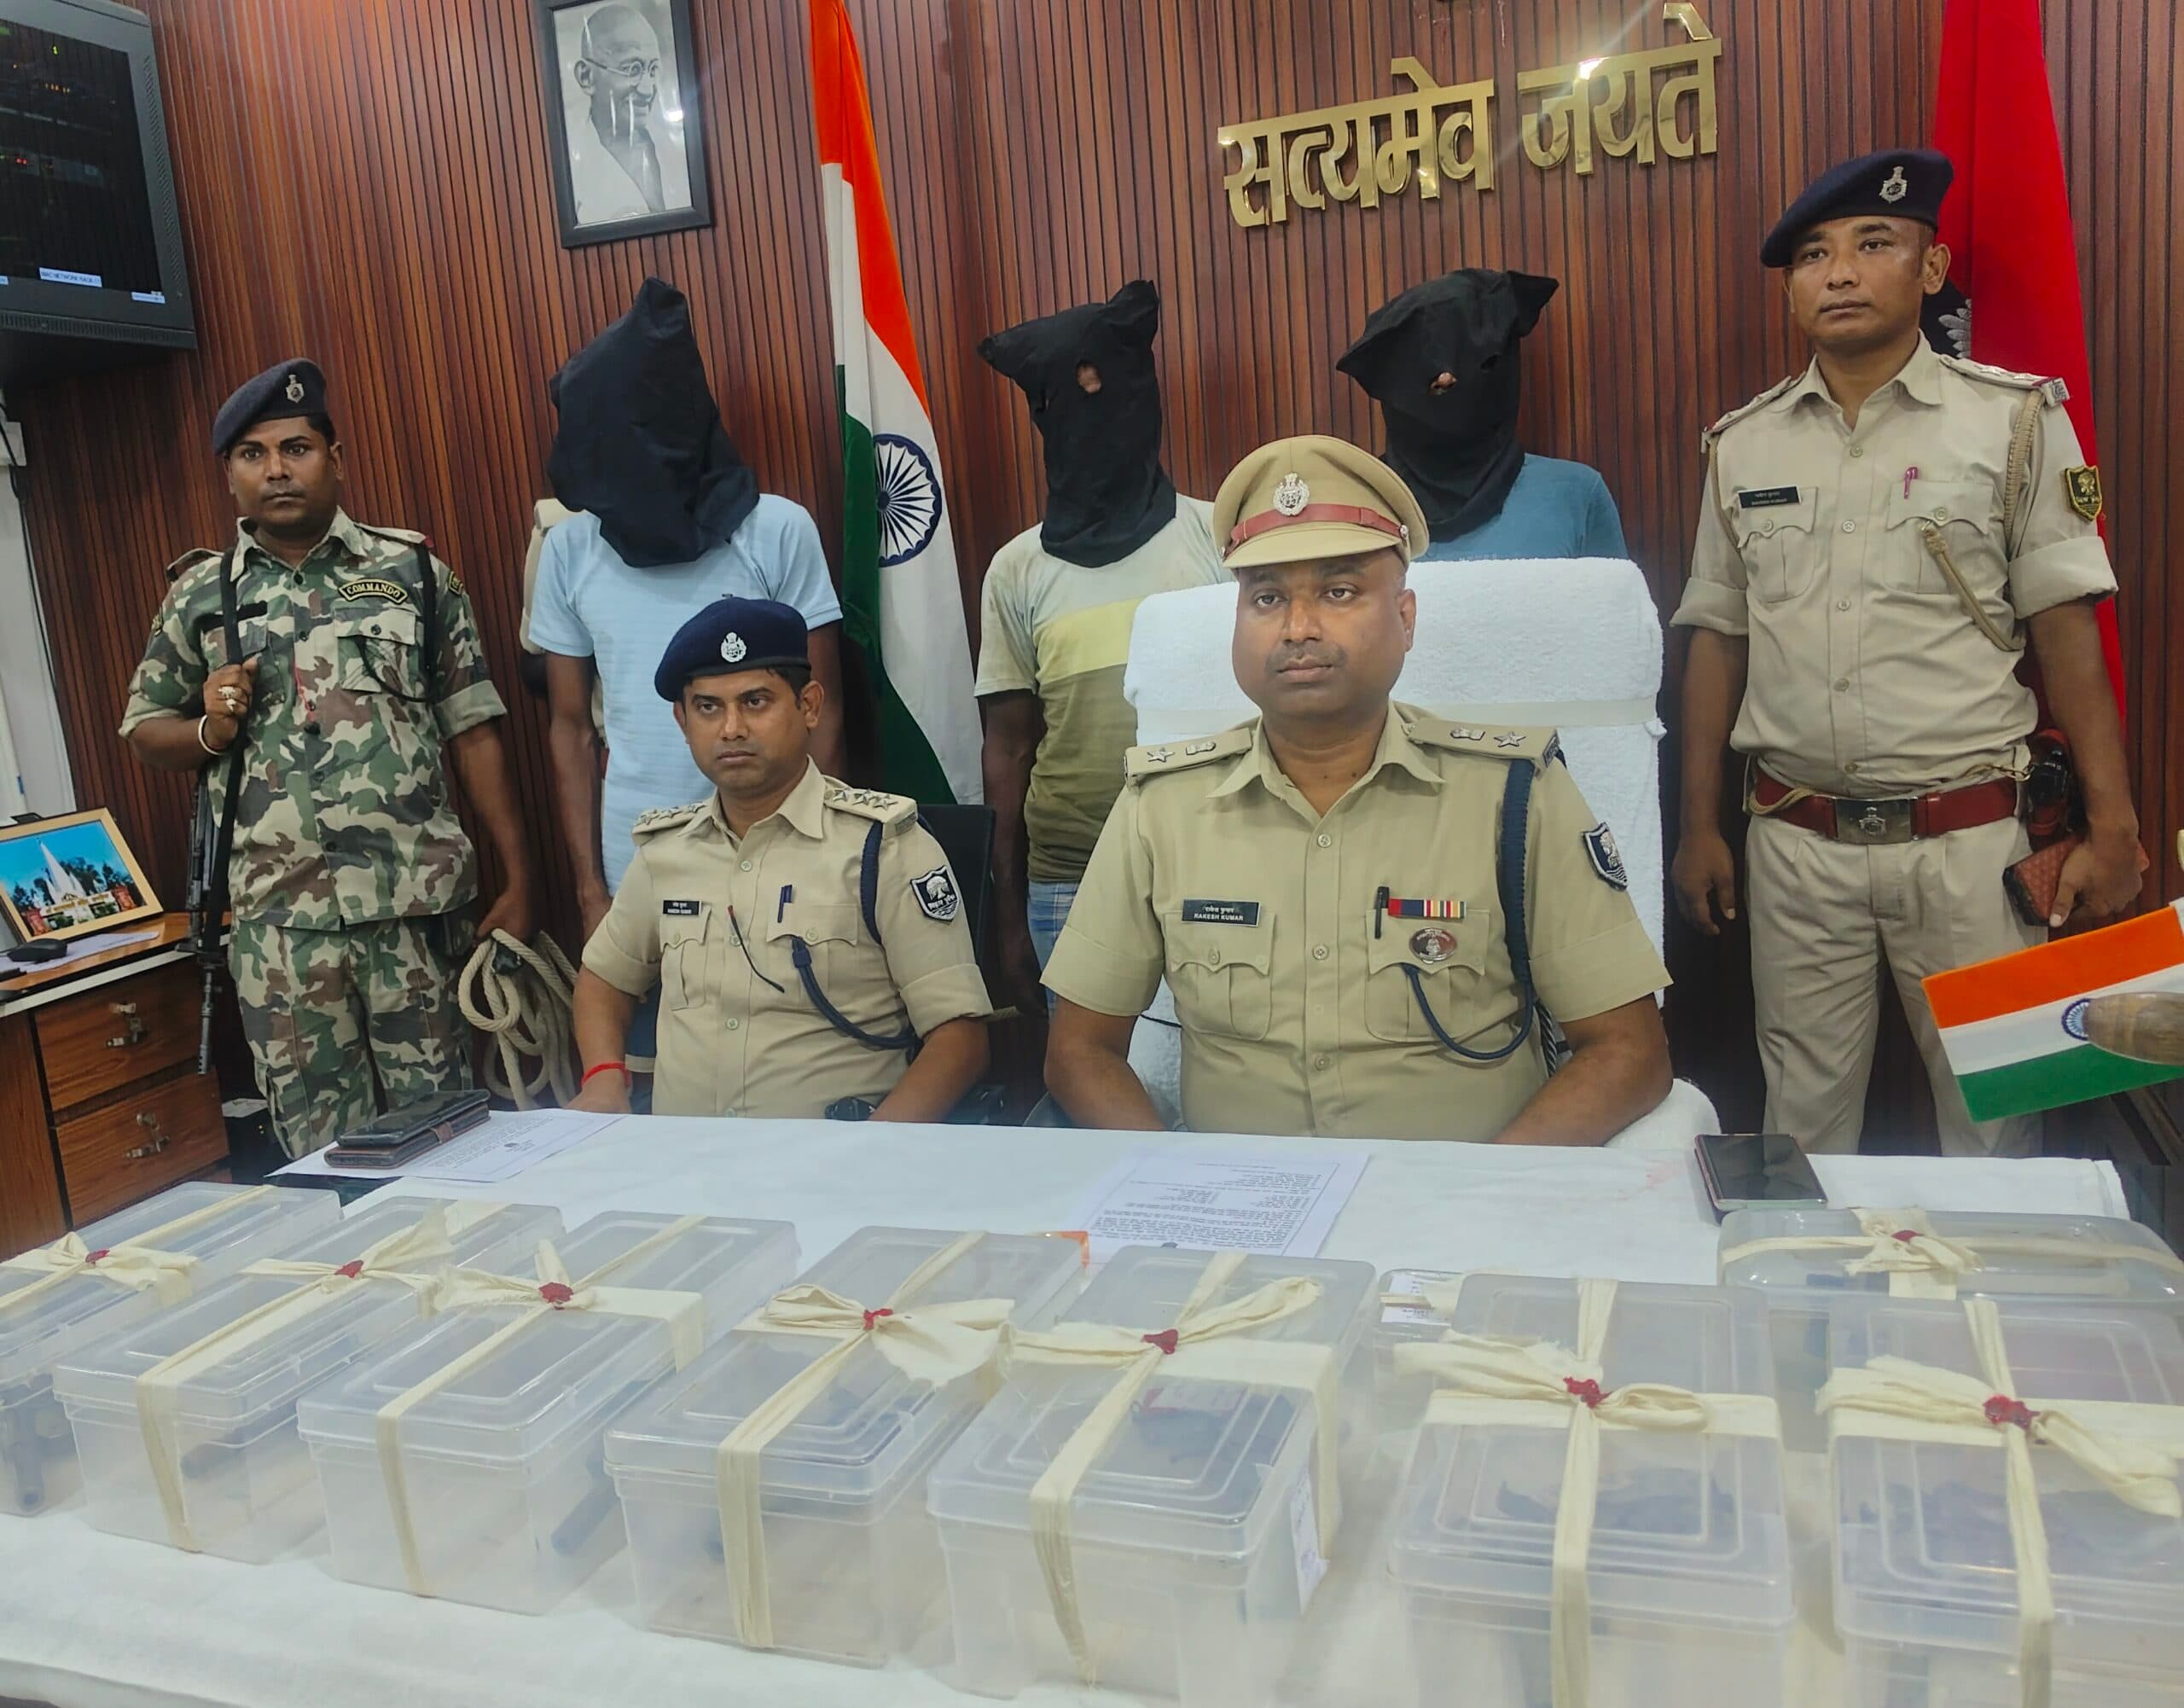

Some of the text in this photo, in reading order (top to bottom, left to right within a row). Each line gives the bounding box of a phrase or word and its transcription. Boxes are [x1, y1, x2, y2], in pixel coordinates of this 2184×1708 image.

[1217, 2, 1722, 228] सत्यमेव जयते
[346, 583, 401, 598] COMMANDO
